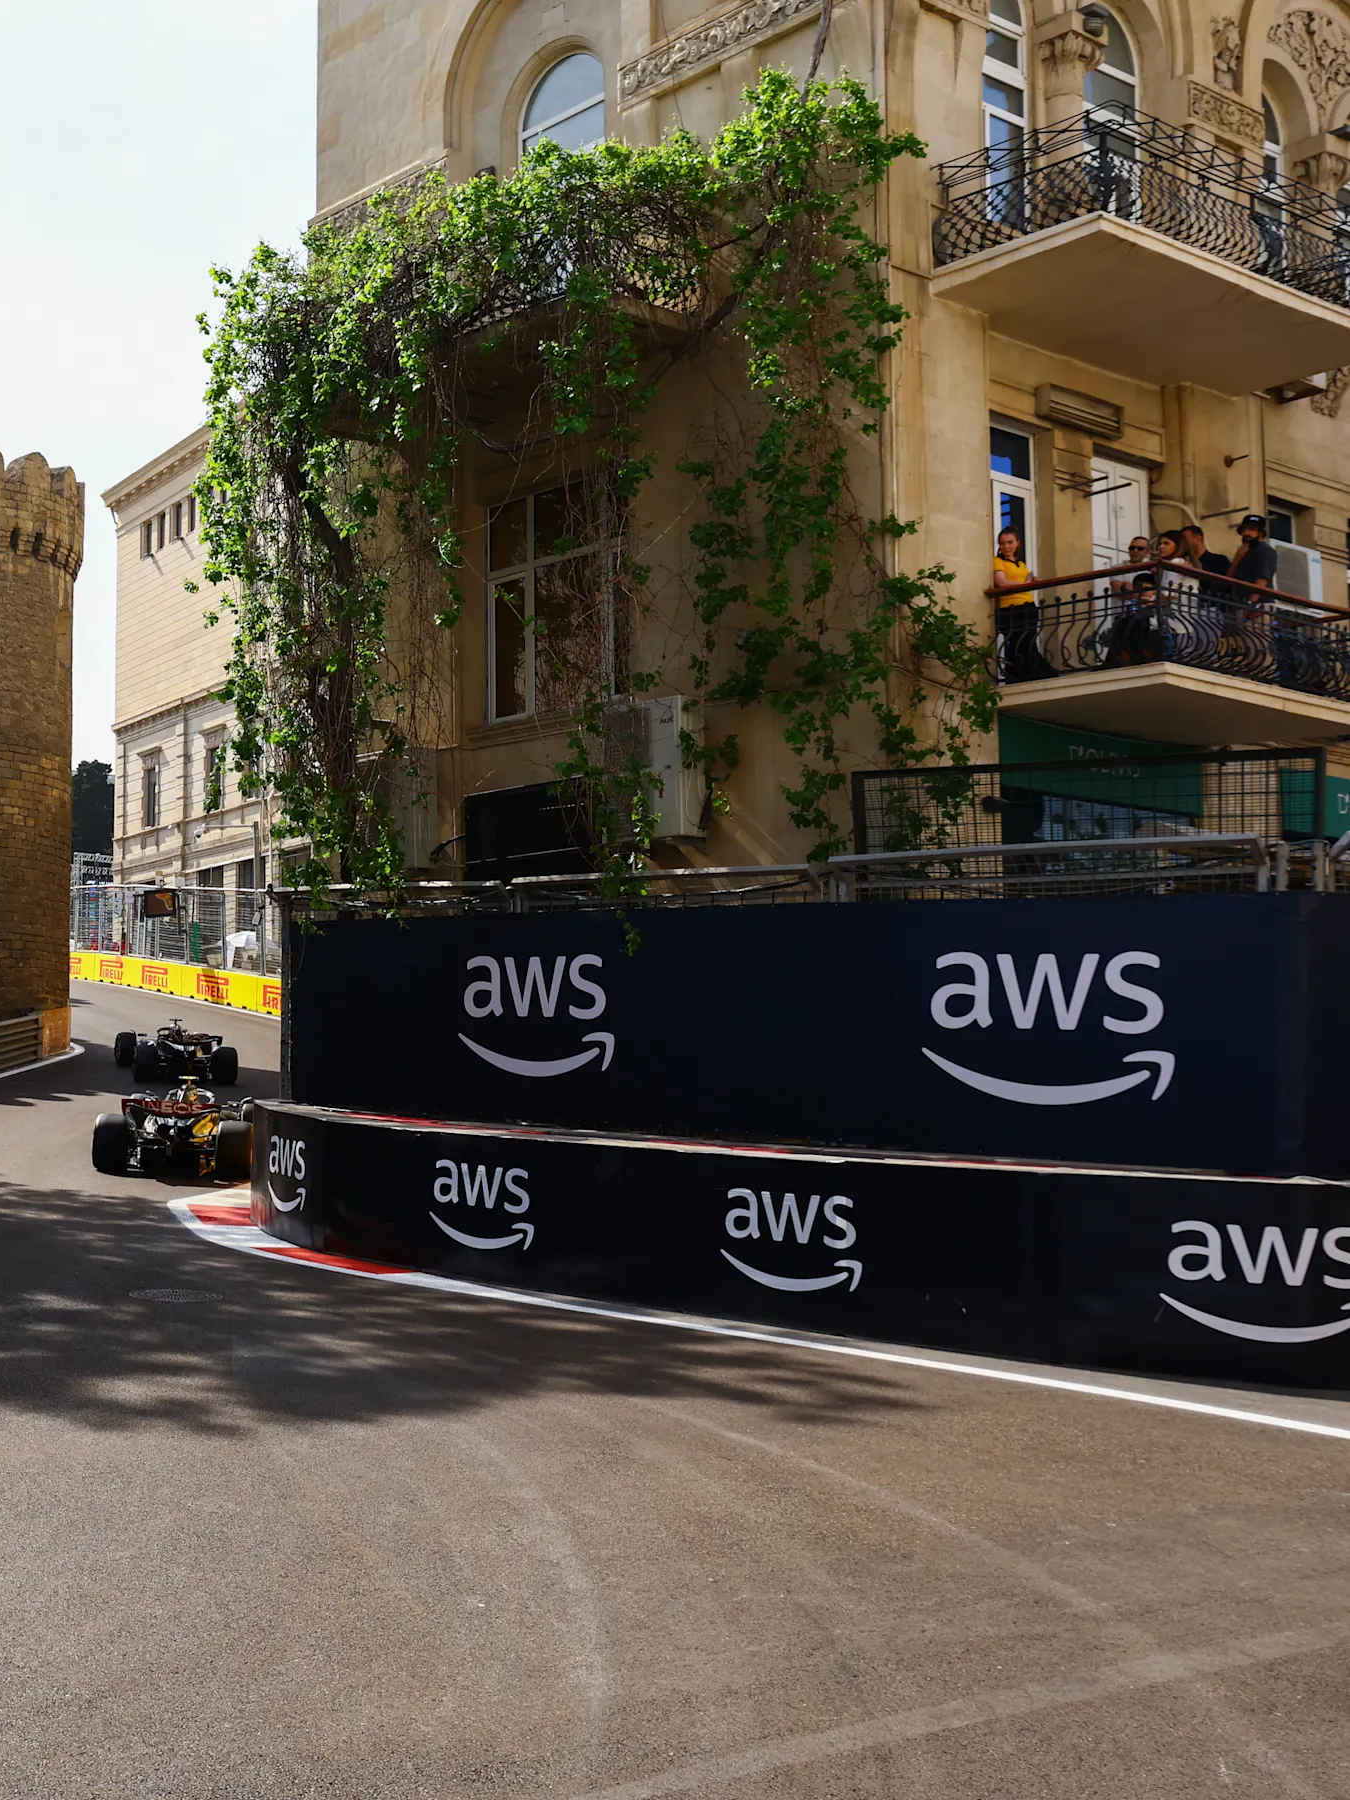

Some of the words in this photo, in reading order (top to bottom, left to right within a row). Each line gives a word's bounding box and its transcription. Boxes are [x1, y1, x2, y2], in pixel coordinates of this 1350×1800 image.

[99, 959, 123, 980] PIRELLI
[141, 964, 168, 989] PIRELLI
[196, 972, 229, 1000] PIRELLI
[463, 953, 607, 1020] aws
[930, 950, 1165, 1034] aws
[142, 1100, 203, 1114] INEOS
[269, 1134, 306, 1181] aws
[433, 1158, 531, 1214] aws
[724, 1187, 857, 1250] aws
